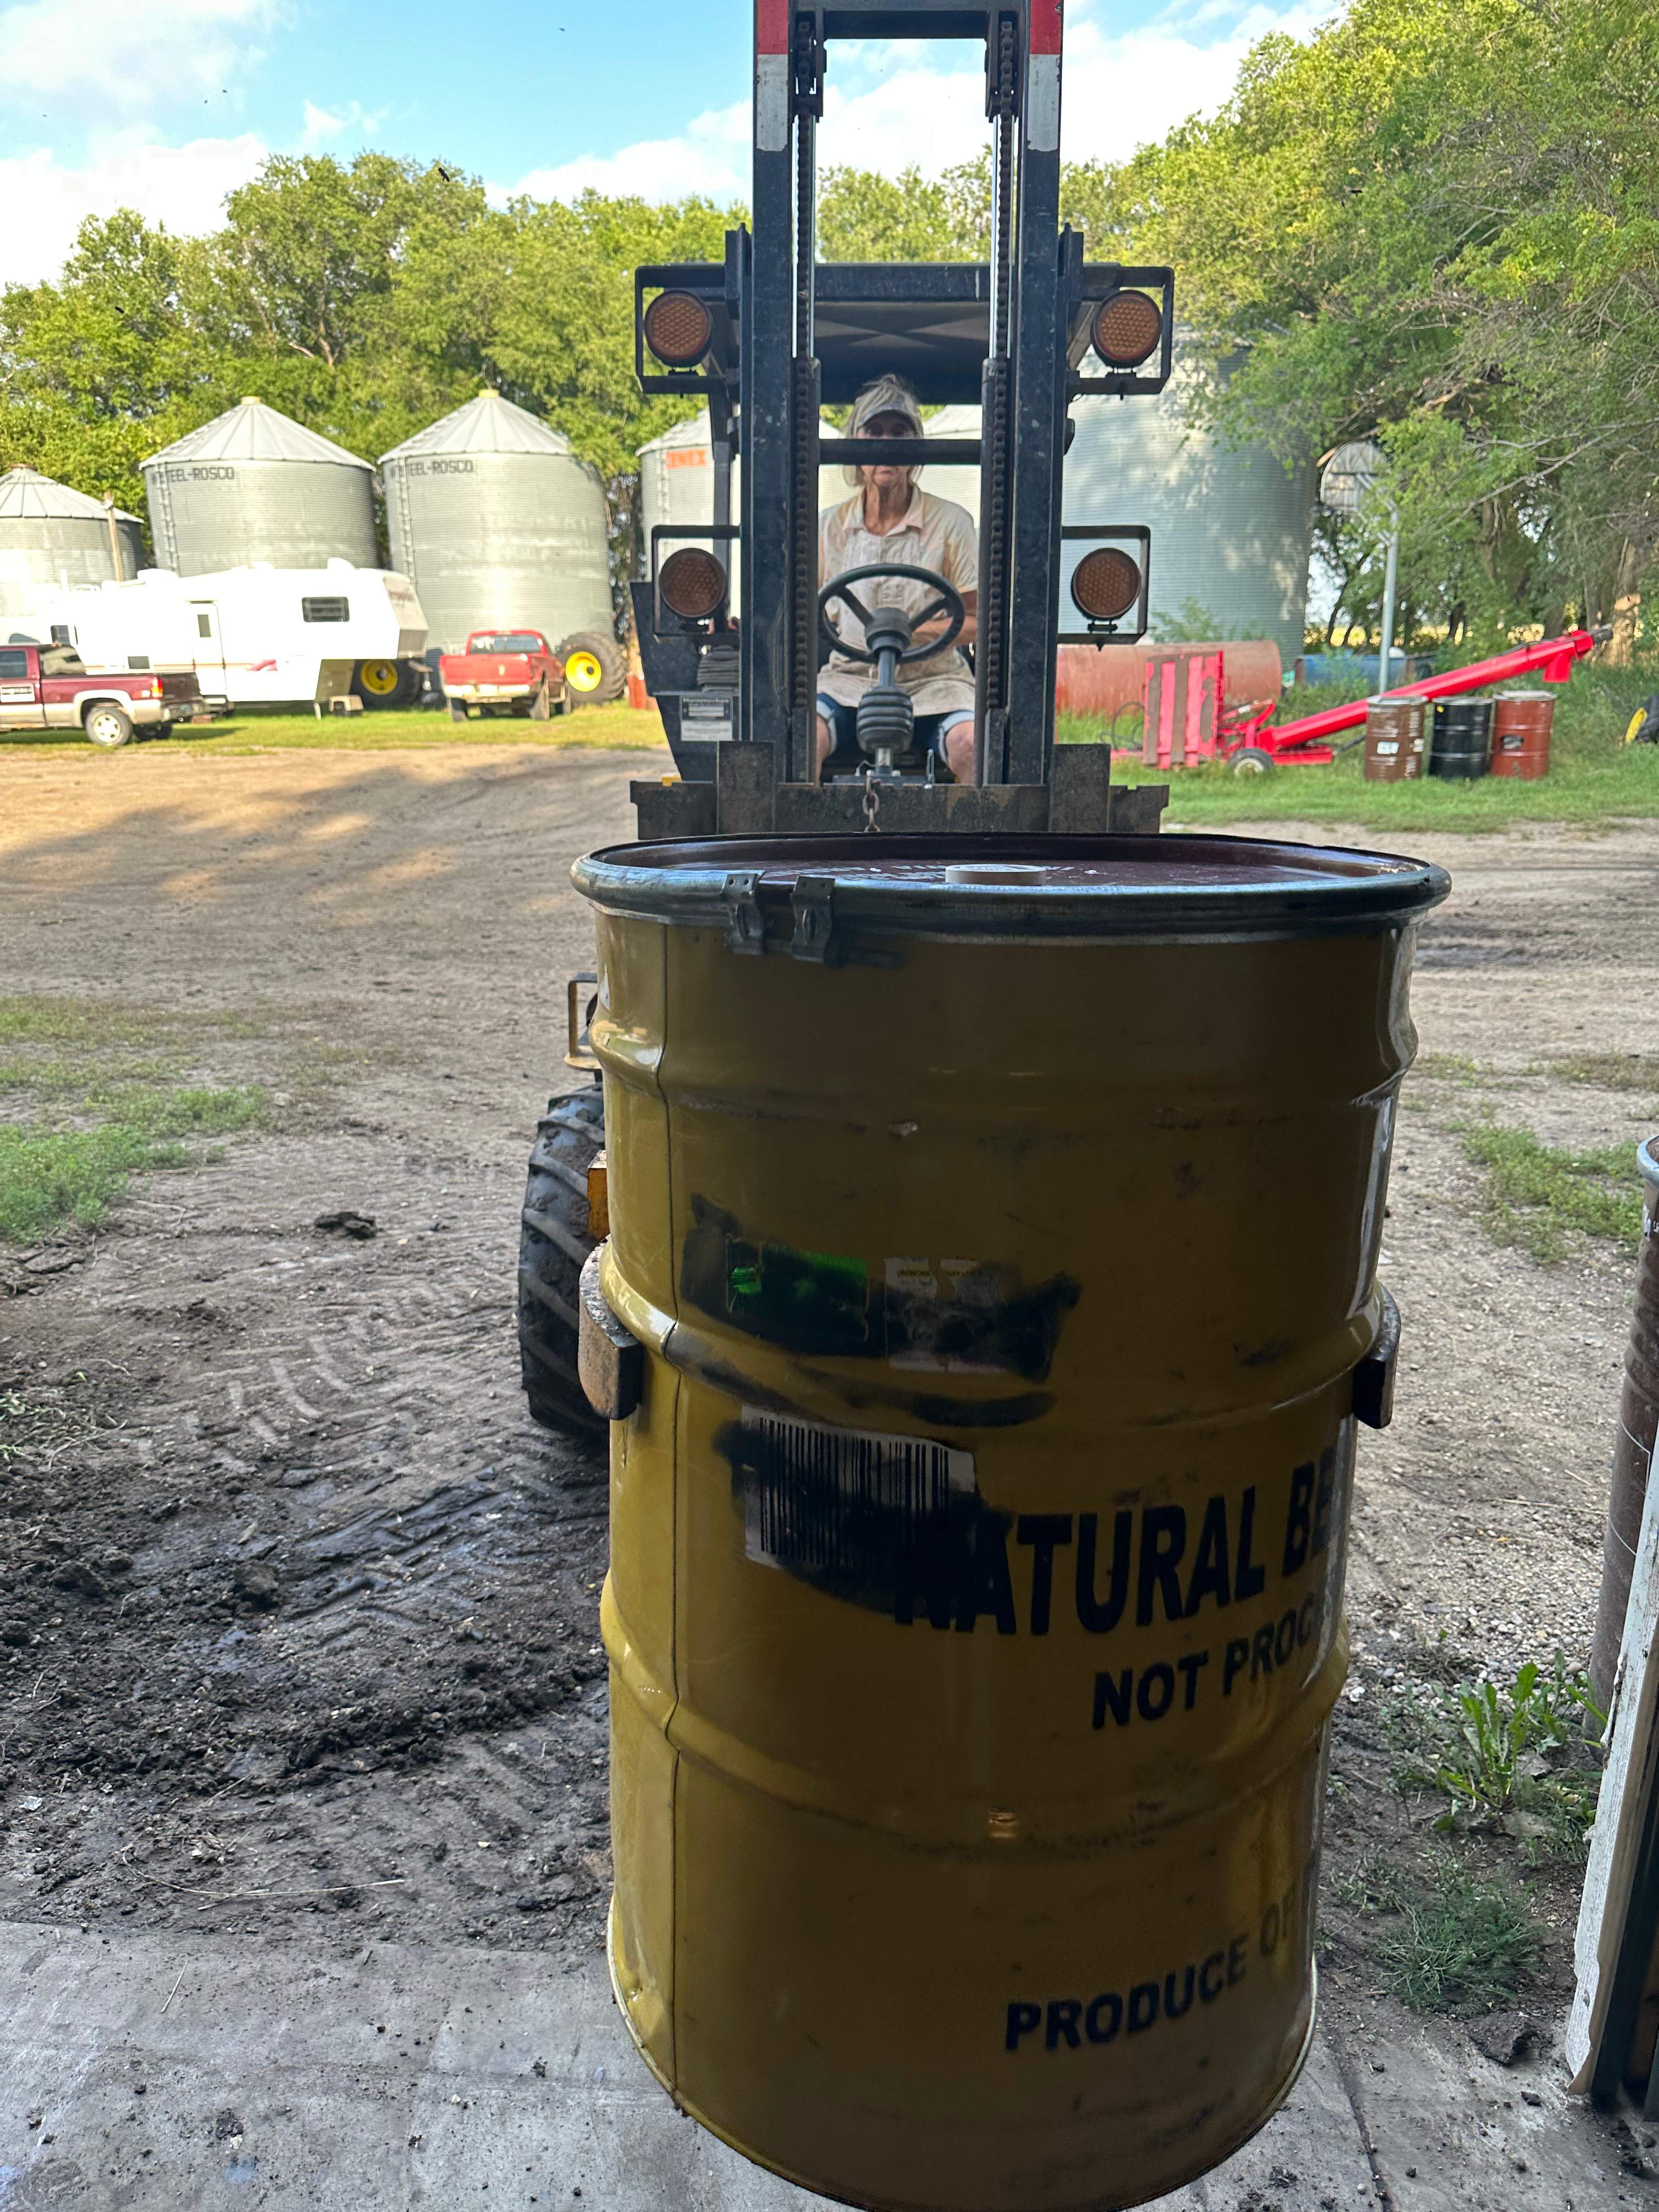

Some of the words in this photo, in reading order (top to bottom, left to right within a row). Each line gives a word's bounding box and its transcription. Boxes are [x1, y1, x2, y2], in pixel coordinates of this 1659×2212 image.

[895, 1485, 1264, 1637] ATURAL
[1093, 1652, 1208, 1729] NOT
[1006, 1931, 1250, 2050] PRODUCE
